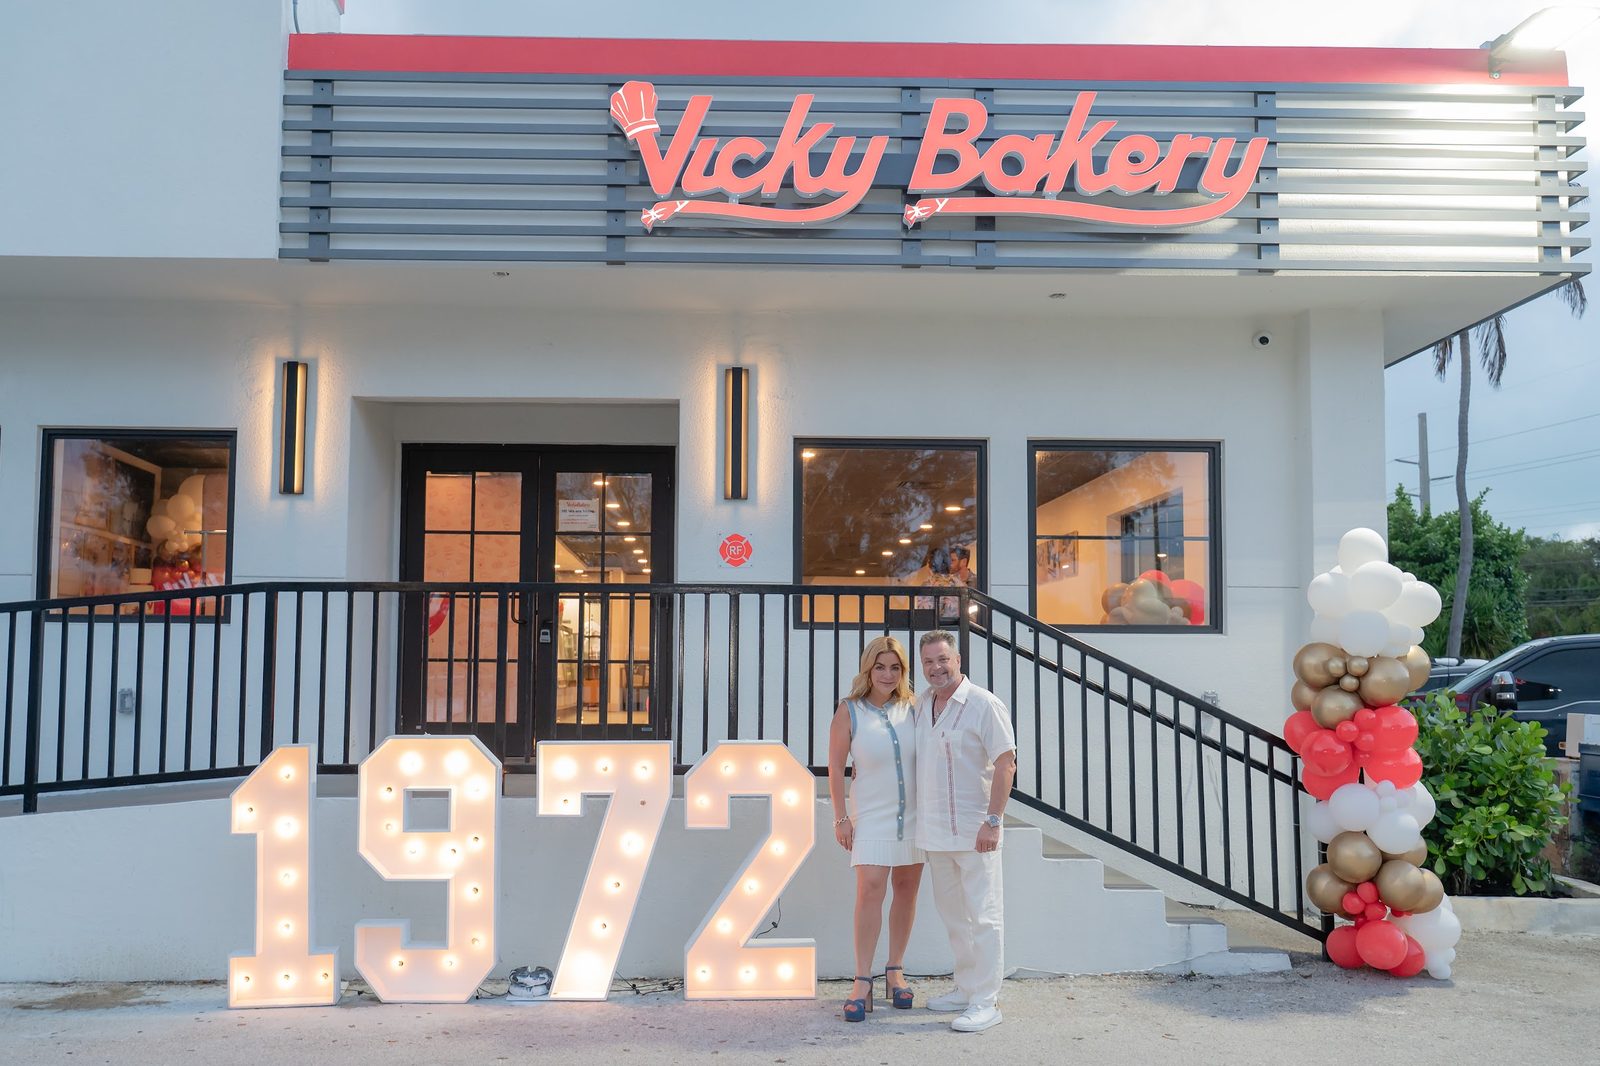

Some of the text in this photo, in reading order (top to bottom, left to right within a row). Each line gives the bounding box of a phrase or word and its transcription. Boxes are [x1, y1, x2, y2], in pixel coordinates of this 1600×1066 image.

[634, 91, 1269, 228] Vicky Bakery
[729, 545, 743, 556] RF
[229, 734, 817, 1007] 1972
